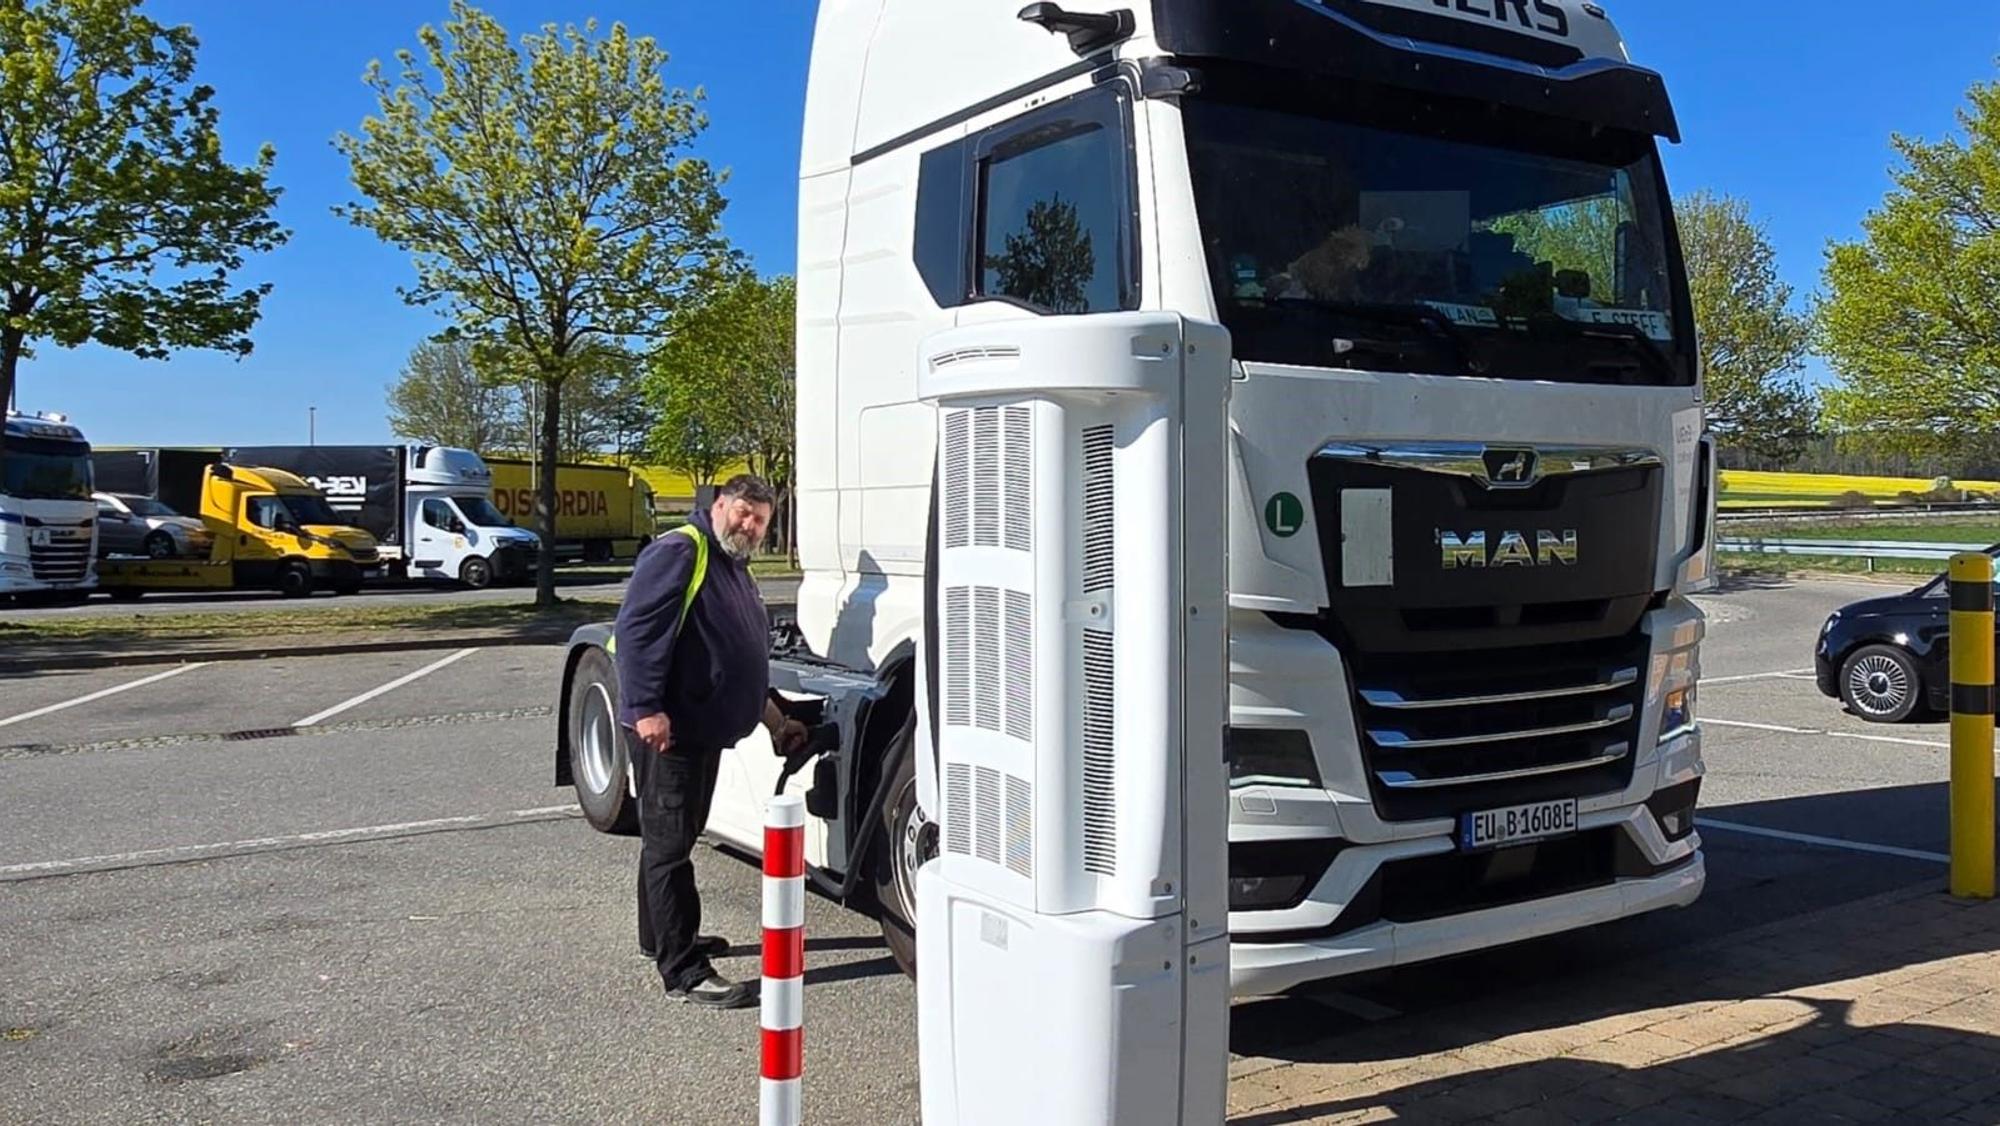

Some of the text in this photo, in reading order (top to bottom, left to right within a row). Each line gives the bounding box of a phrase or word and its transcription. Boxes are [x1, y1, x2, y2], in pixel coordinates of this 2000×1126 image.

[494, 488, 608, 517] DISRDIA
[1276, 500, 1294, 531] L
[1441, 530, 1577, 569] MAN
[1474, 813, 1496, 842] EU
